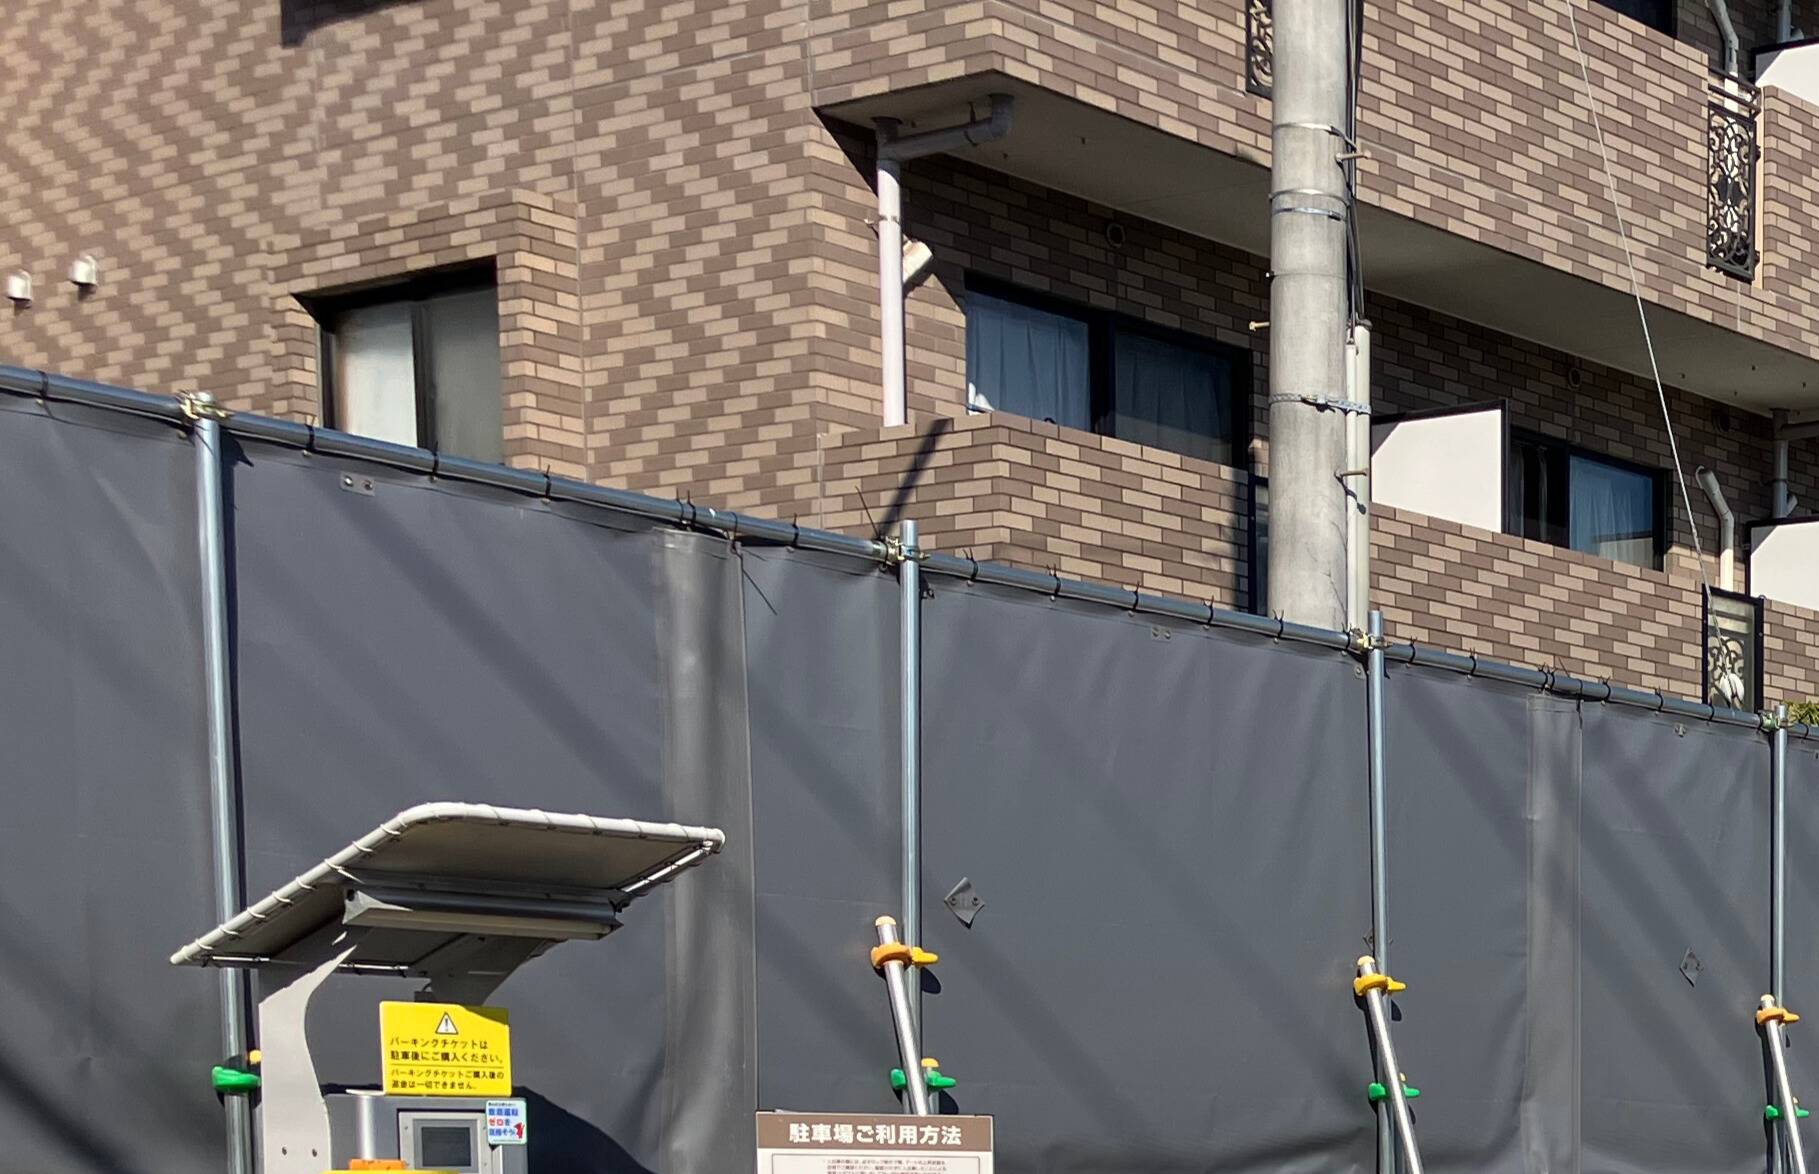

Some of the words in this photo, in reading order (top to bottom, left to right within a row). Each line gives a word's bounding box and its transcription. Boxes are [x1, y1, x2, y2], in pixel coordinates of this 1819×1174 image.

[390, 1037, 488, 1049] パーキングチケットは
[390, 1051, 503, 1063] 駐車後にご購入ください。
[789, 1123, 962, 1145] 駐車場ご利用方法
